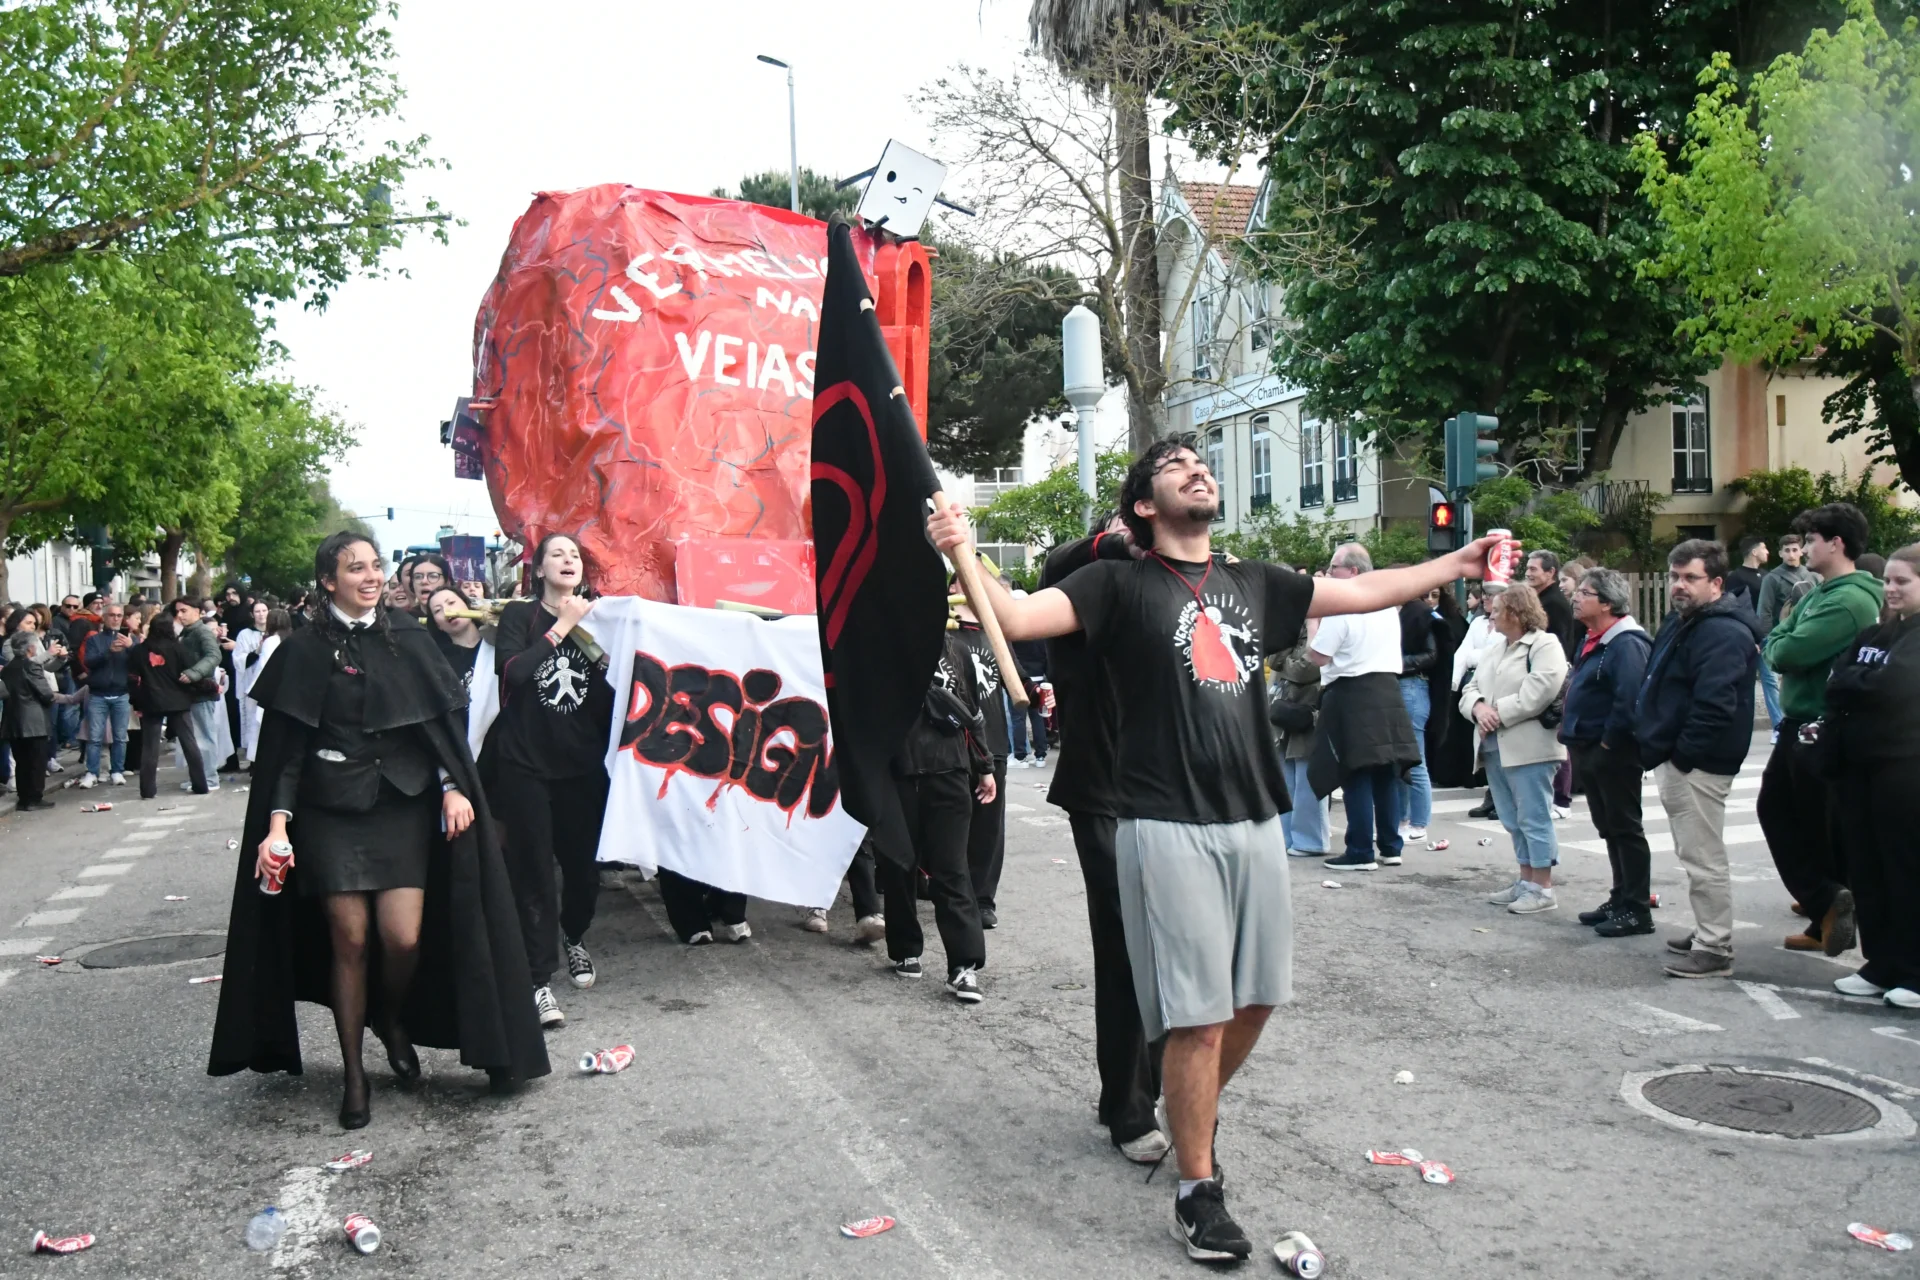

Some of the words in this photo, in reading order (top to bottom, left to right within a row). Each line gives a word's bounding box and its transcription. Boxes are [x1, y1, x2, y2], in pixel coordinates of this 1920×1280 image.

[756, 286, 823, 322] NA
[674, 329, 818, 400] VEIAS
[1194, 405, 1210, 419] Casa
[1173, 600, 1198, 647] VERMELHO
[1856, 646, 1892, 665] ST
